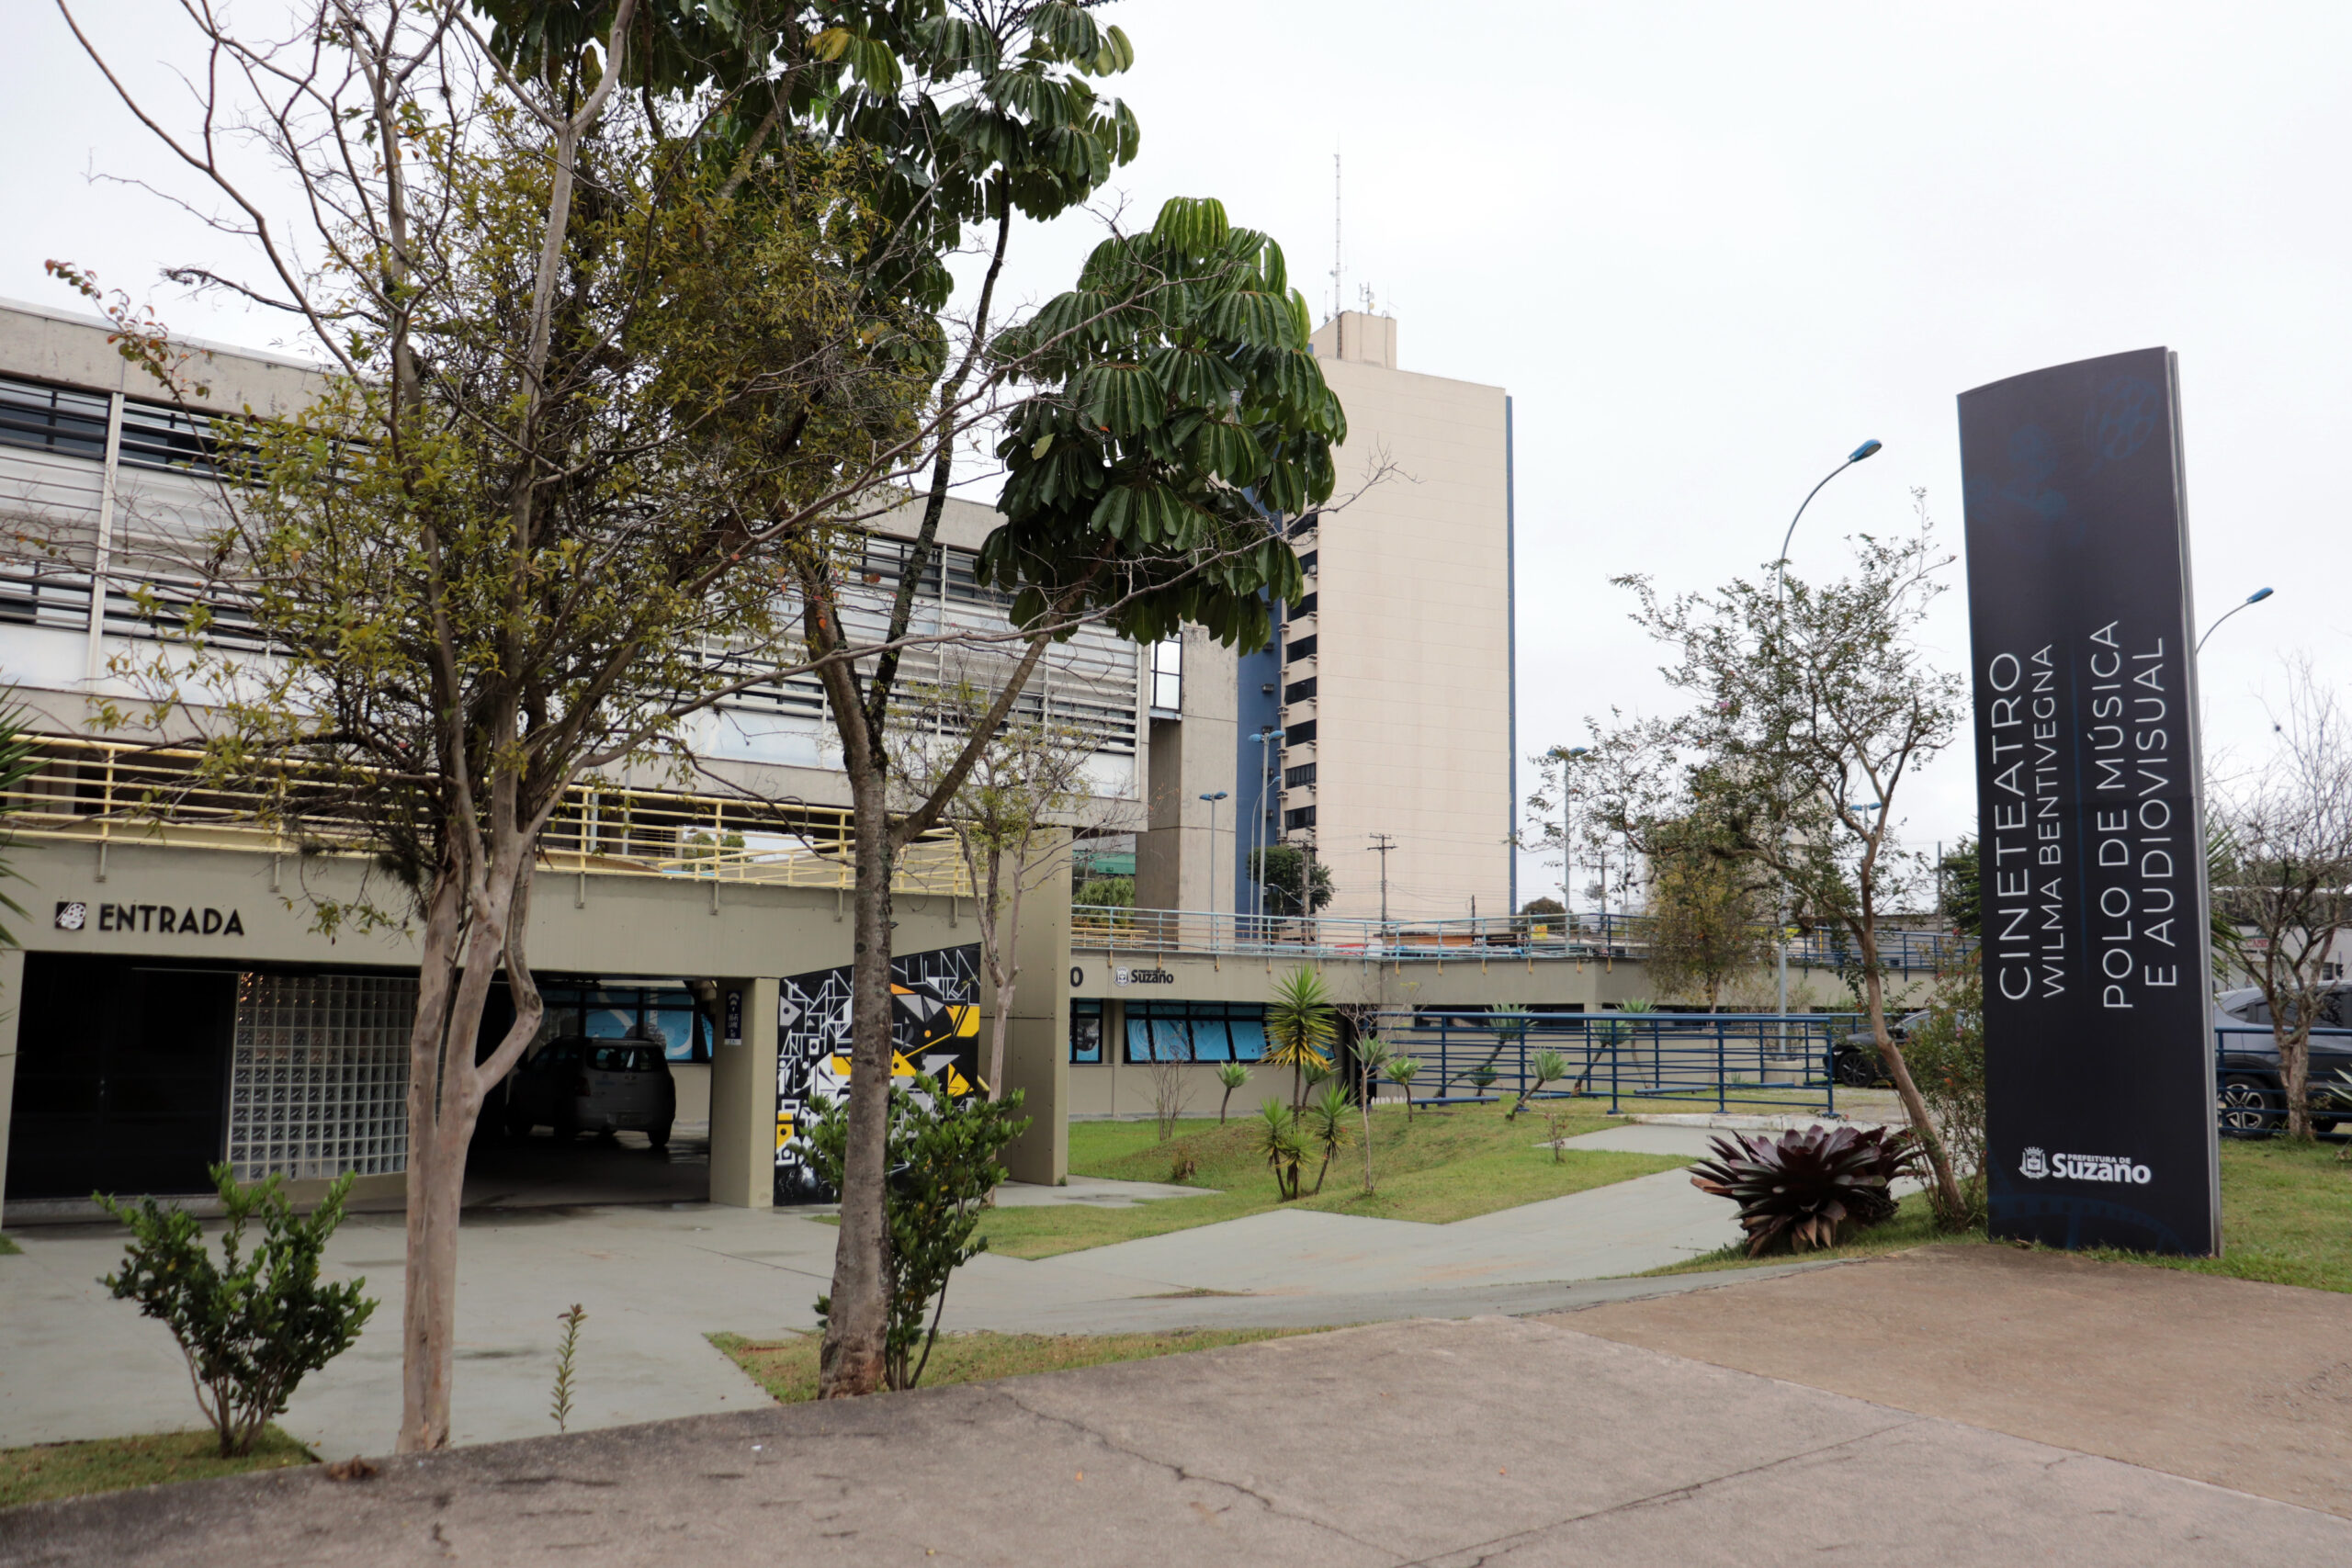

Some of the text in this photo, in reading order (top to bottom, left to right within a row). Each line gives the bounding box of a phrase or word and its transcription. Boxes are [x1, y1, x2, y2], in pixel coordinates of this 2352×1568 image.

[1989, 653, 2031, 999] CINETEATRO
[2030, 644, 2064, 998] WILMA BENTIVEGNA
[2087, 620, 2132, 1008] POLO DE MÚSICA
[2132, 637, 2177, 986] E AUDIOVISUAL
[98, 903, 244, 935] ENTRADA
[1131, 969, 1174, 984] Suzano
[2052, 1153, 2152, 1184] Suzano
[2067, 1154, 2117, 1163] PREFEITURA
